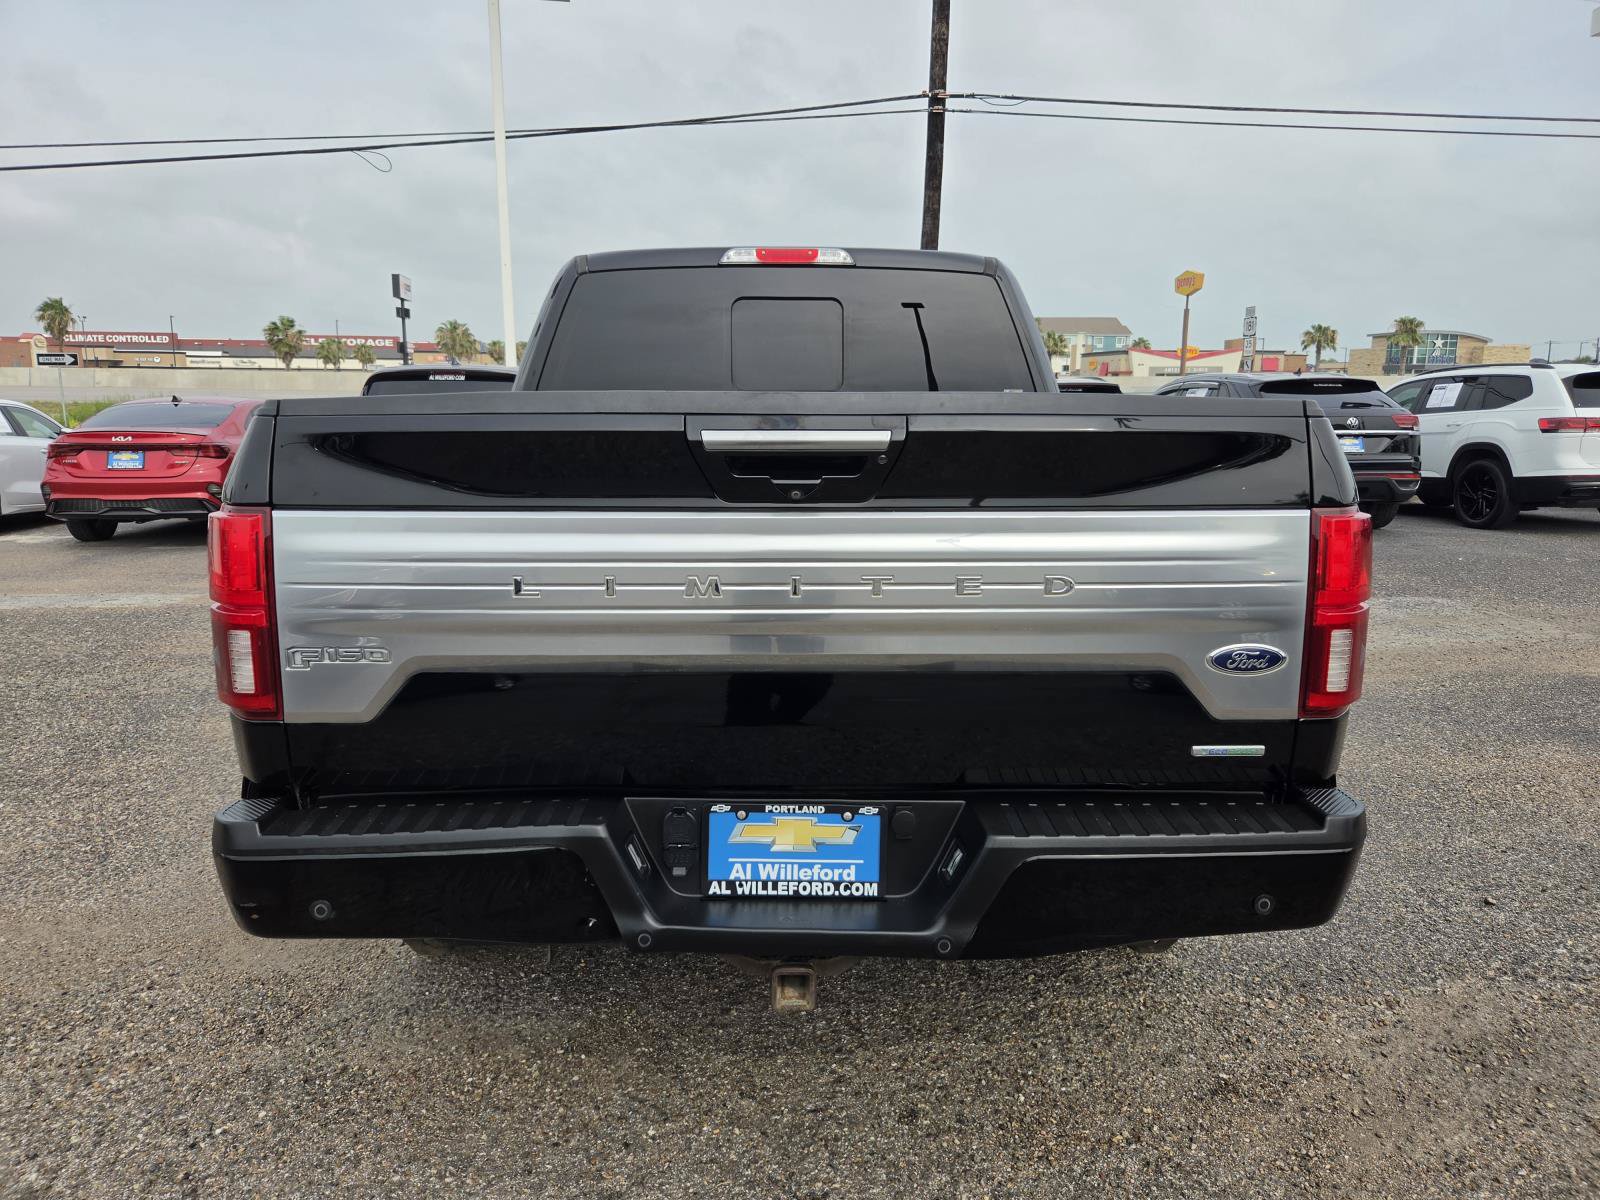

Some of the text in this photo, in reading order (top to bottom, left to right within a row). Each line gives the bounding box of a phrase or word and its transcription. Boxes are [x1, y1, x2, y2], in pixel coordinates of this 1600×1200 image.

[63, 334, 169, 343] CLIMATE CONTROLLED
[334, 338, 394, 347] ORAGE
[513, 576, 1076, 598] LIMITED
[1226, 650, 1270, 669] Ford
[765, 804, 826, 814] PORTLAND
[729, 863, 856, 881] Al Willeford
[708, 881, 878, 896] AL WILLEFORD.COM
